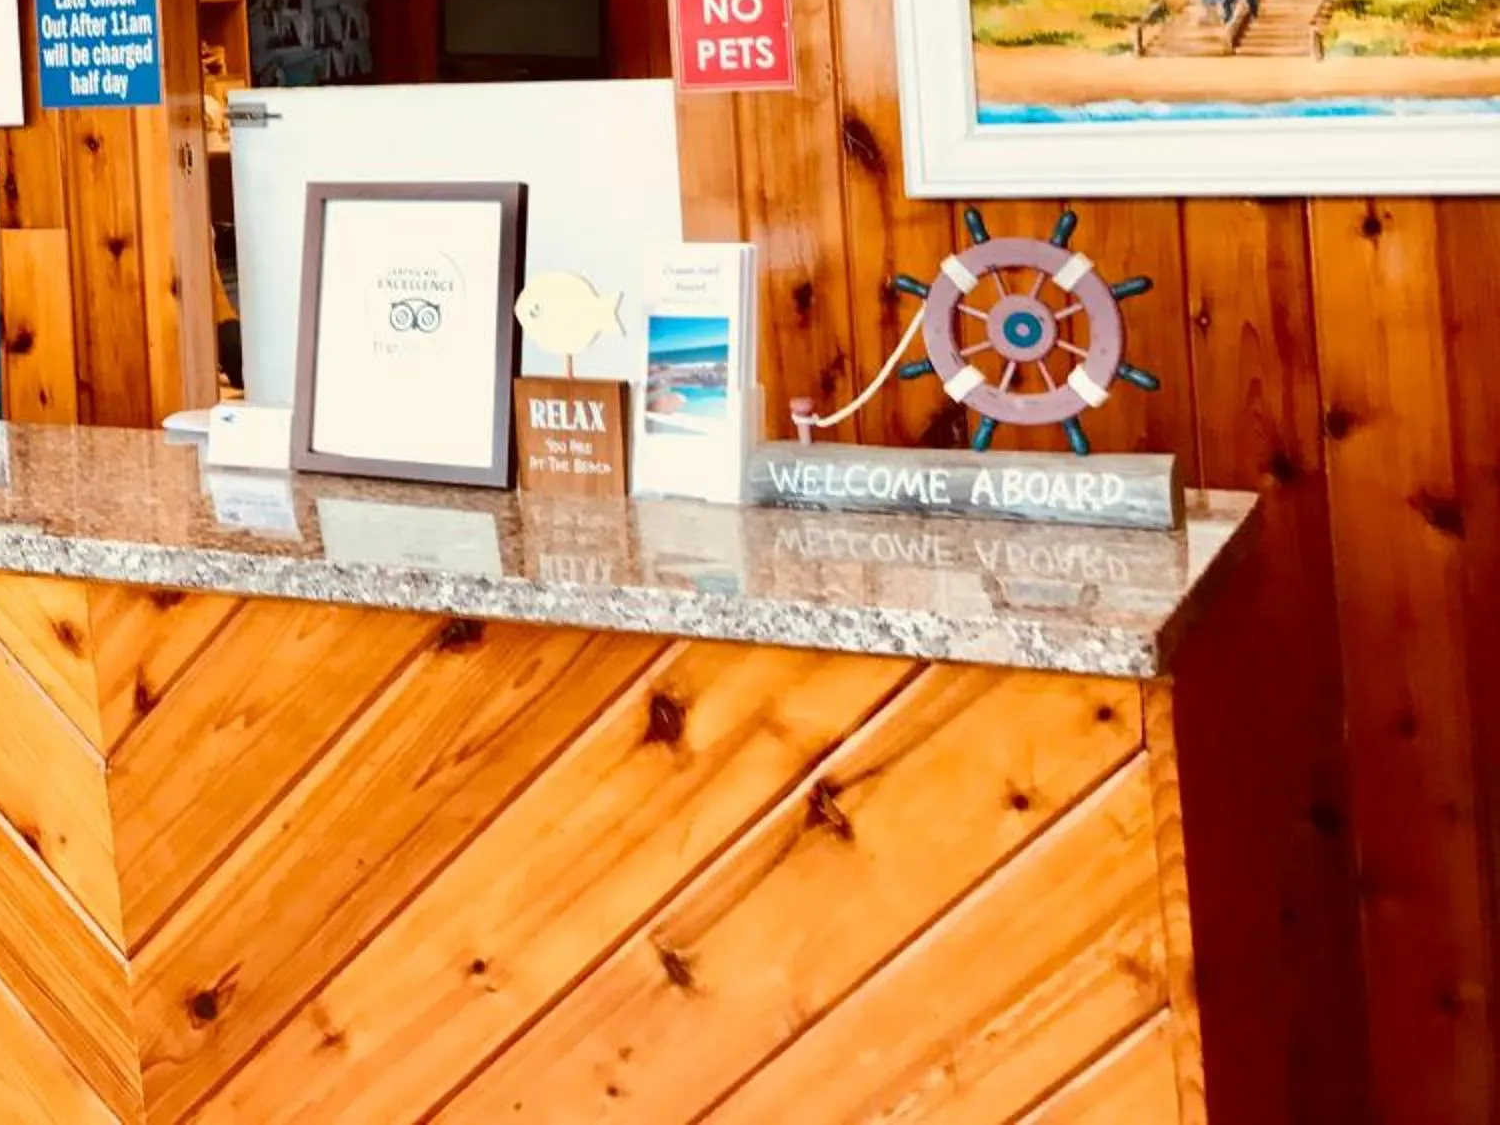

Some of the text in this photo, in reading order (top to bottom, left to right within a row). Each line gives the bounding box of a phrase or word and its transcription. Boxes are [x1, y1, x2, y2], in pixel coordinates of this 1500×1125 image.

[41, 10, 152, 39] Out After 11am
[43, 39, 152, 71] will be charged
[696, 36, 776, 71] PETS
[70, 69, 129, 99] half day
[529, 398, 607, 432] RELAX
[768, 461, 1125, 511] WELCOME ABOARD
